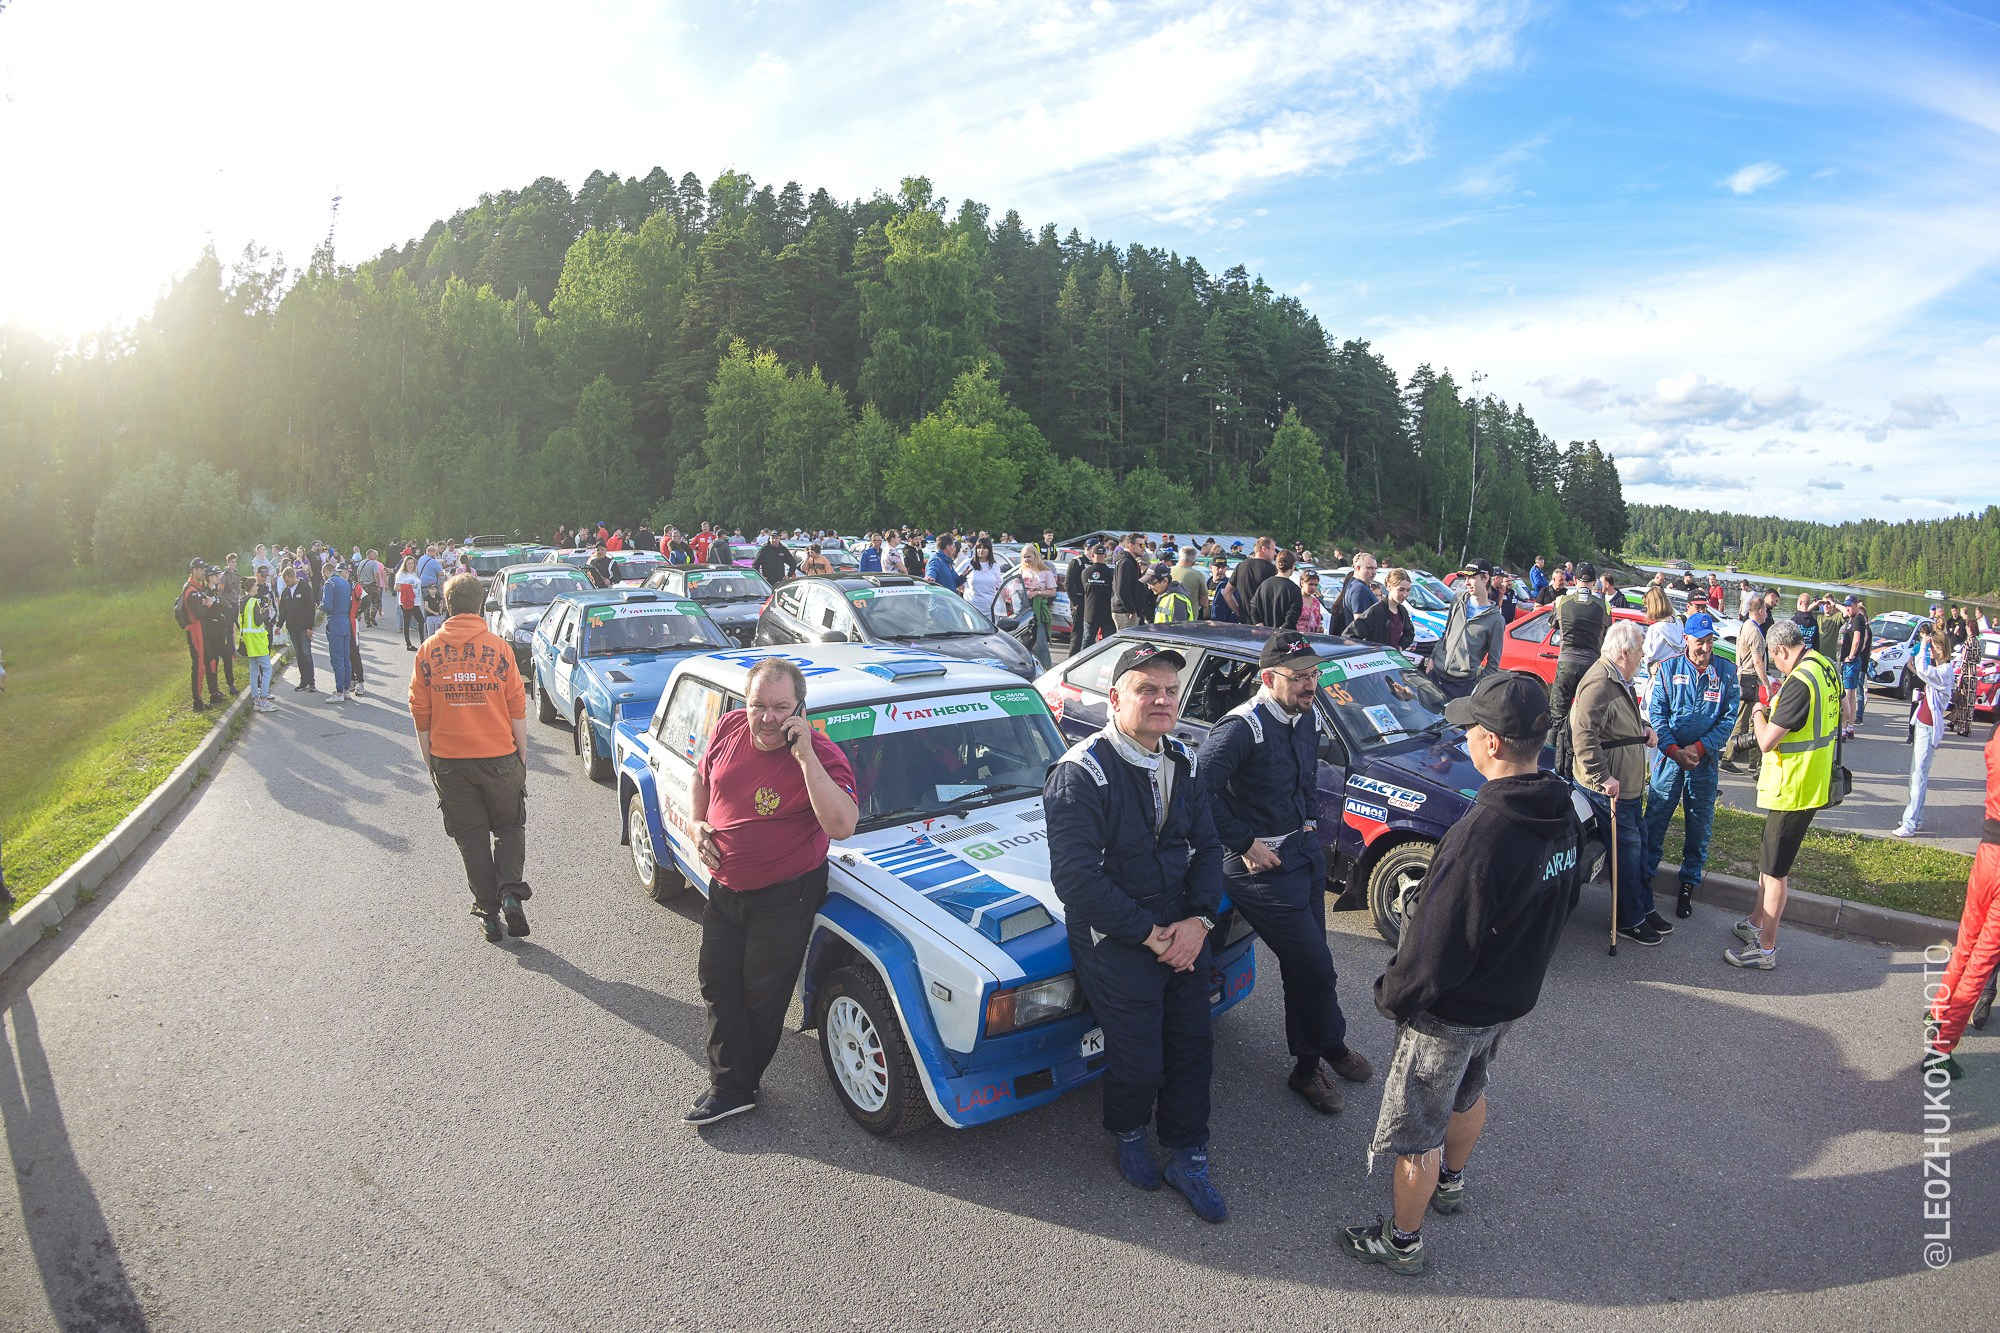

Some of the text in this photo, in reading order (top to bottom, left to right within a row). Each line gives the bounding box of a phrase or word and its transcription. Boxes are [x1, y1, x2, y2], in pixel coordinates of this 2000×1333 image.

[1354, 659, 1392, 671] ТАТНЕФТЬ
[453, 672, 477, 682] 1999
[1324, 683, 1354, 706] 56
[902, 702, 989, 721] ТАТНЕФТЬ
[1349, 775, 1426, 803] МАСТЕР
[1389, 797, 1419, 810] СПОРТ
[955, 1080, 1013, 1113] LADA
